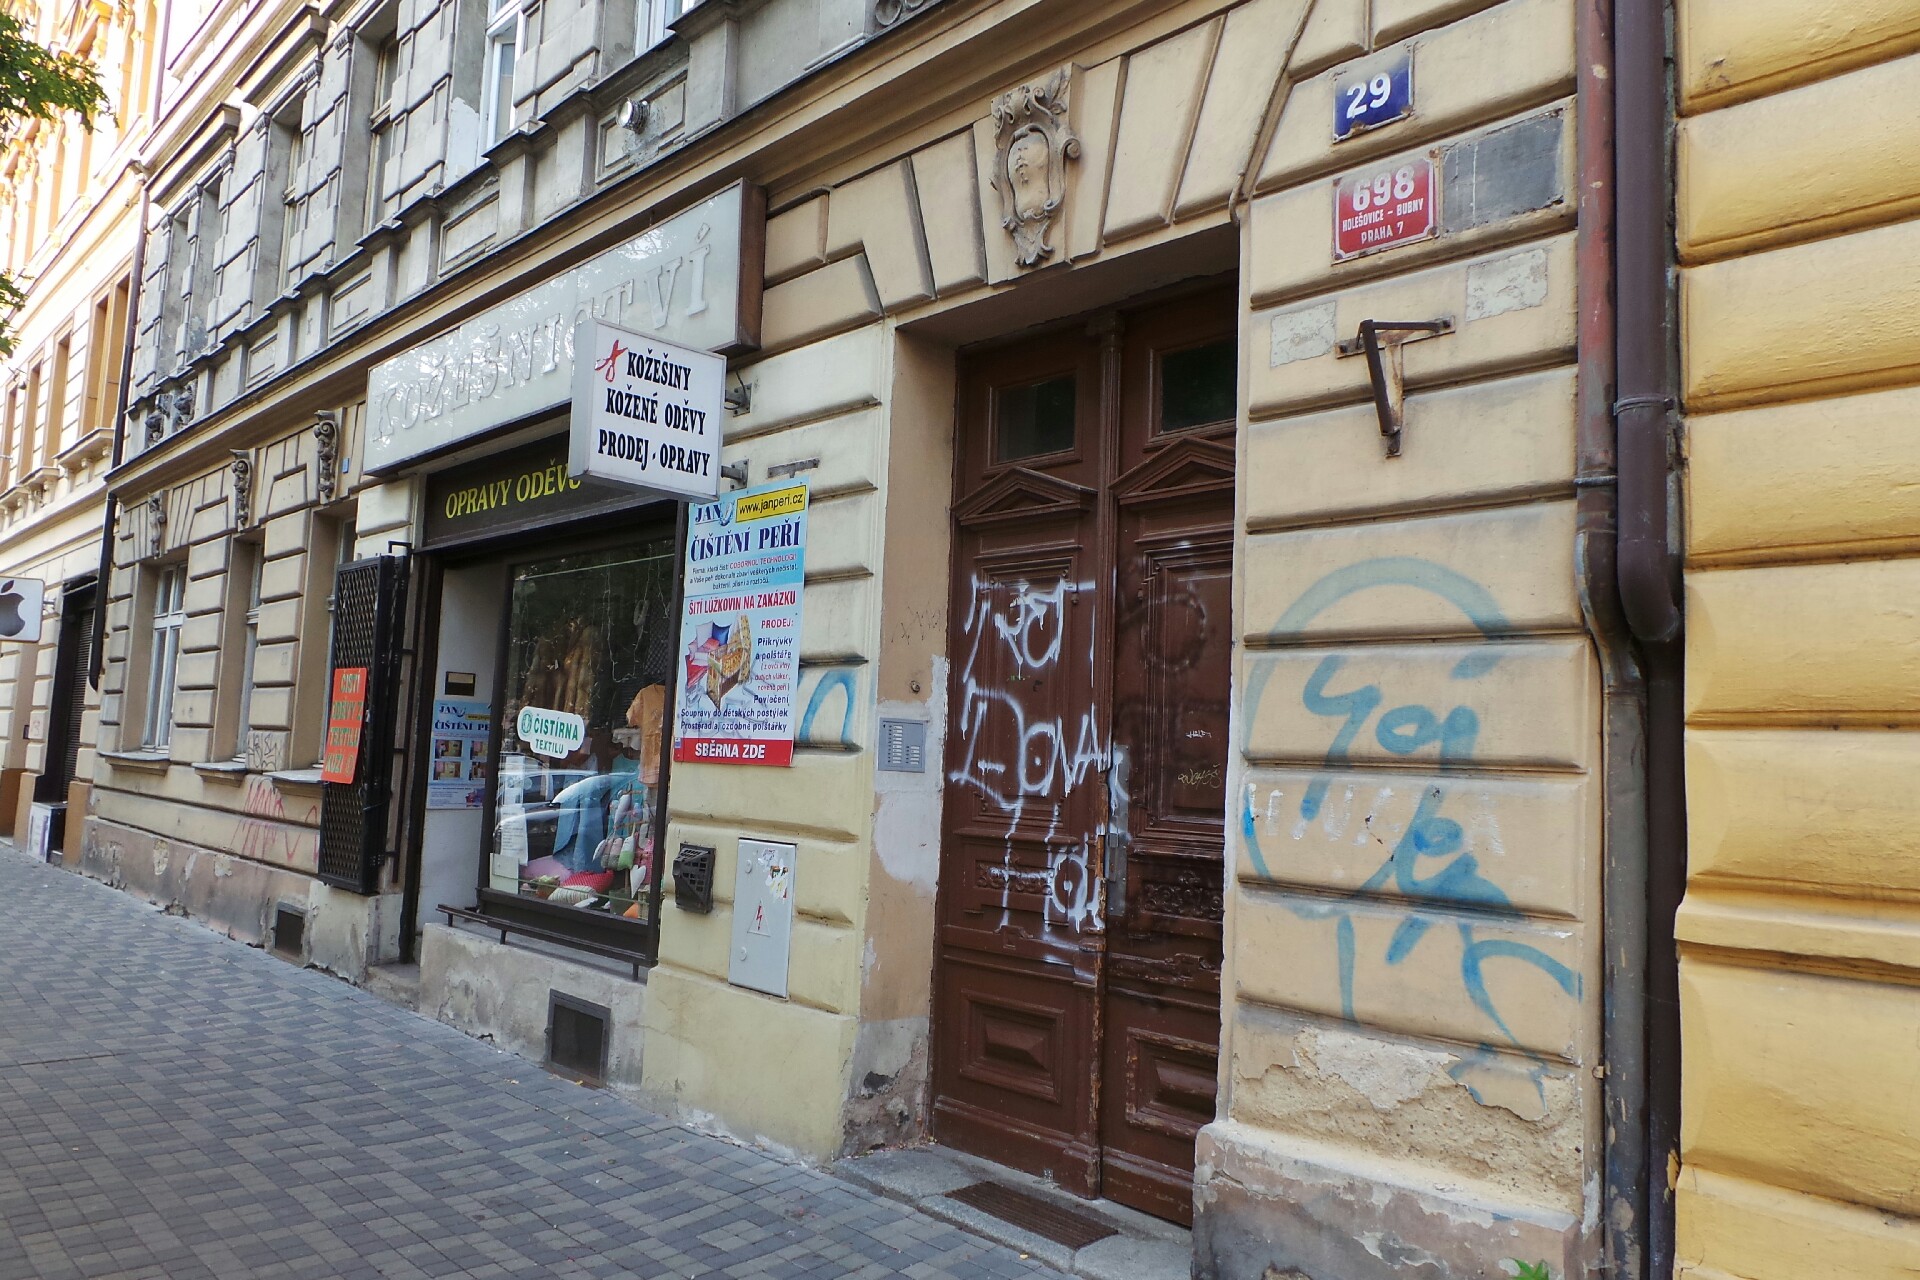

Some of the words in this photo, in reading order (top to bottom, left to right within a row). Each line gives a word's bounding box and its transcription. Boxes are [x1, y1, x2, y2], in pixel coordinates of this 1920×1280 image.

[1346, 72, 1391, 119] 29
[1352, 165, 1415, 211] 698
[1342, 208, 1384, 232] HOLEŠOVICE
[1396, 198, 1424, 217] BUBNY
[1361, 224, 1393, 244] PRAHA
[1397, 221, 1404, 235] 7
[626, 348, 691, 391] KOŽEŠINY
[605, 384, 658, 424] KOŽENÉ
[664, 399, 706, 435] ODĚVY
[598, 429, 649, 471] PRODEJ
[659, 443, 710, 476] OPRAVY
[445, 478, 512, 519] OPRAVY
[694, 504, 721, 522] JAN
[739, 493, 804, 515] www.janperi.cz
[690, 526, 751, 562] ČIŠTĚNÍ
[758, 516, 801, 550] PEŘÍ
[688, 596, 703, 616] ŠITÍ
[743, 595, 755, 610] NA
[757, 588, 796, 608] ZAKÁZKU
[761, 619, 794, 629] PRODEJ:
[761, 650, 792, 662] polštáře
[439, 705, 459, 714] JAN
[680, 708, 711, 719] Soupravy
[713, 708, 721, 717] do
[723, 708, 755, 719] dětských
[757, 708, 788, 719] postýlek
[434, 720, 473, 731] ČIŠTĚNÍ
[533, 713, 579, 742] ČISTÍRNA
[721, 722, 751, 731] ozdobné
[752, 721, 787, 732] polštářky
[535, 738, 564, 755] TEXTILU
[695, 741, 739, 759] SBĚRNA
[742, 743, 766, 759] ZDE
